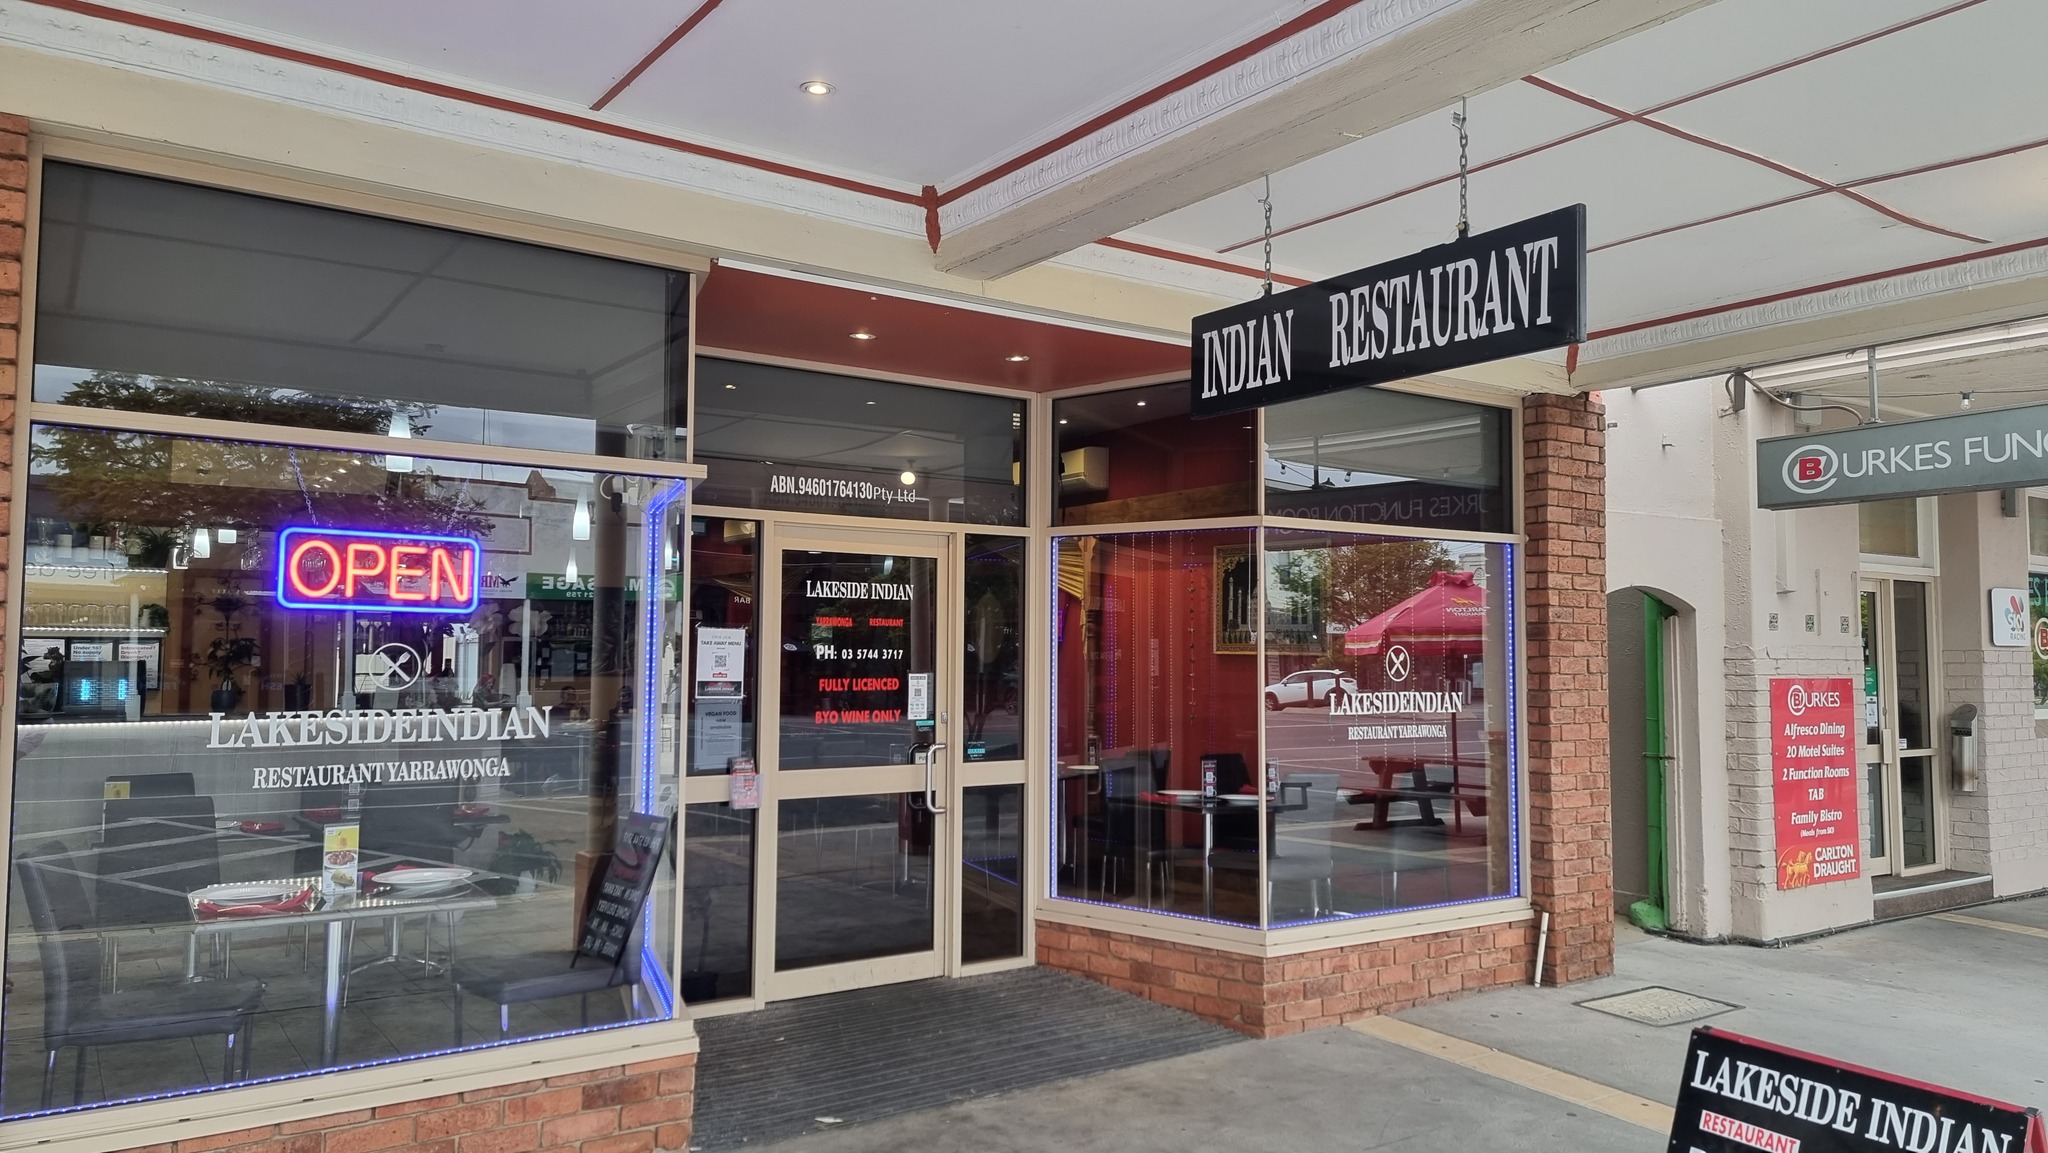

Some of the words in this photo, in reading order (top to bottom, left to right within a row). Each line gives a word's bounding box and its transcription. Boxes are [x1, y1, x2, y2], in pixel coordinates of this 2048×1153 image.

[1201, 309, 1294, 399] INDIAN
[1329, 236, 1558, 368] RESTAURANT
[897, 489, 916, 503] Ltd
[287, 538, 471, 603] OPEN
[806, 580, 868, 599] LAKESIDE
[871, 583, 914, 600] INDIAN
[816, 616, 853, 627] YARRAWONGA
[869, 618, 904, 627] RESTAURANT
[2010, 633, 2026, 641] RACING
[816, 644, 838, 660] PH:
[841, 649, 853, 660] 03
[856, 649, 879, 660] 5744
[882, 649, 903, 660] 3717
[819, 679, 850, 691] FULLY
[853, 678, 899, 691] LICENCED
[815, 711, 838, 724] BYO
[841, 711, 870, 723] WINE
[872, 710, 901, 723] ONLY
[1348, 725, 1398, 740] RESTAURANT
[1398, 724, 1447, 738] YARRAWONGA
[1784, 723, 1819, 739] Alfresco
[1820, 722, 1845, 738] Dining
[1786, 746, 1797, 758] 20
[1798, 745, 1820, 757] Motel
[1821, 744, 1845, 756] Suites
[252, 763, 385, 789] RESTAURANT
[388, 757, 510, 782] YARRAWONGA
[1782, 768, 1788, 780] 2
[1789, 767, 1824, 779] Function
[1824, 766, 1850, 777] Rooms
[1808, 788, 1824, 800] TAB
[1791, 811, 1819, 826] Family
[1820, 809, 1843, 822] Bistro
[1814, 844, 1854, 862] CARLTON
[1813, 859, 1857, 878] DRAUGHT
[1690, 1050, 1862, 1134] LAKESIDE
[1864, 1097, 2012, 1153] INDIAN
[1701, 1111, 1798, 1153] RESTAURANT
